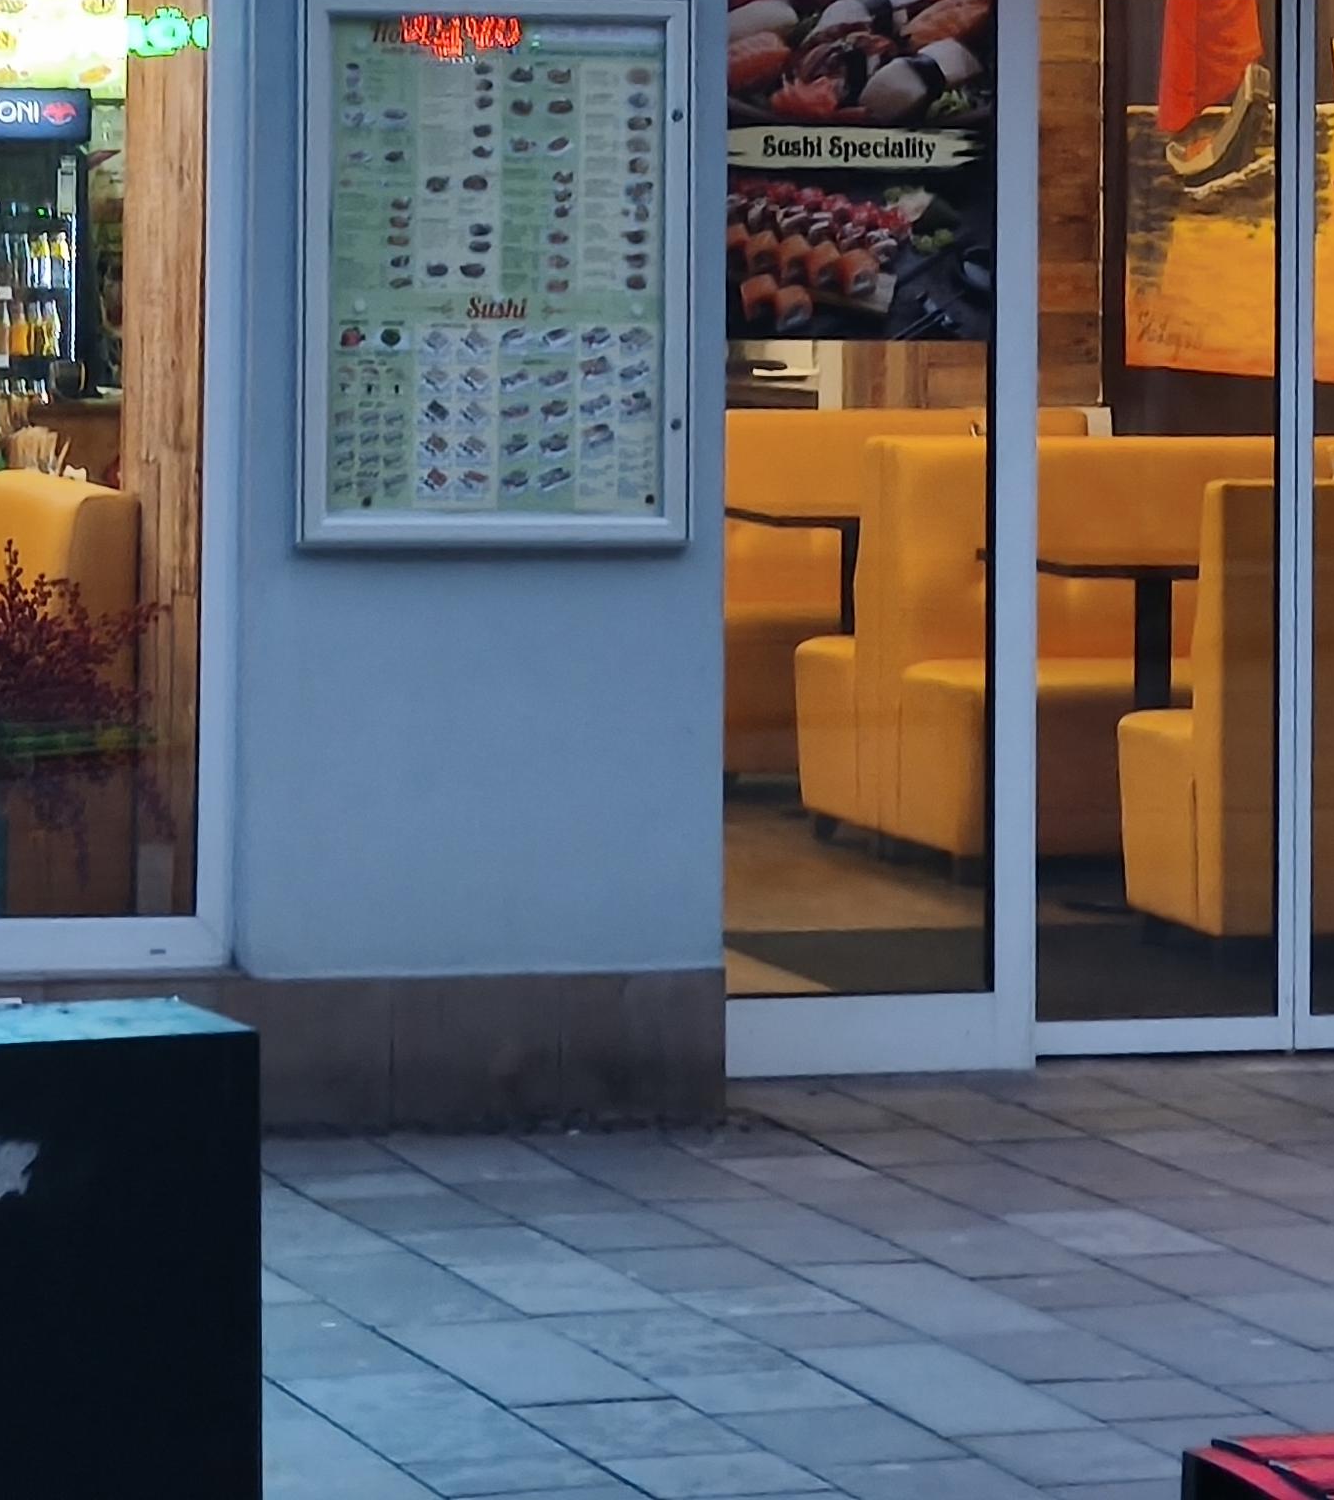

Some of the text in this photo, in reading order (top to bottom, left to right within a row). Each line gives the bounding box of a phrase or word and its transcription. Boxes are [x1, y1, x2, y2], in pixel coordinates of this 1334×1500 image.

[763, 134, 937, 163] Sushi Speciality
[467, 297, 528, 319] Sushi
